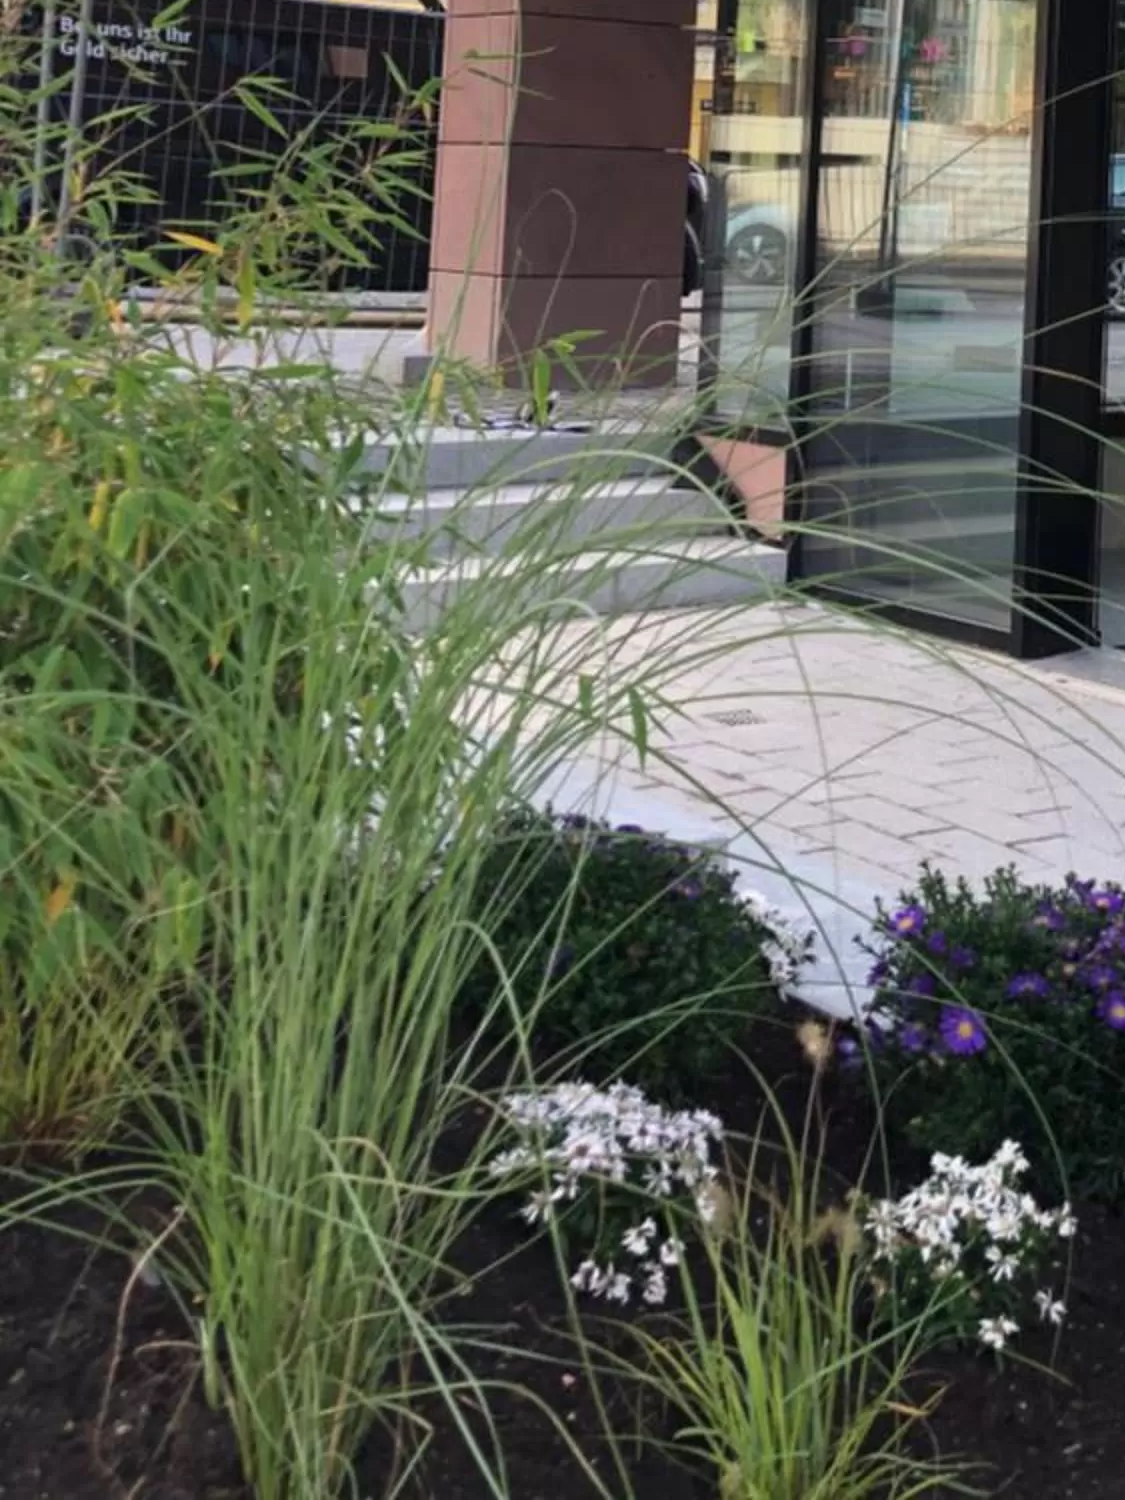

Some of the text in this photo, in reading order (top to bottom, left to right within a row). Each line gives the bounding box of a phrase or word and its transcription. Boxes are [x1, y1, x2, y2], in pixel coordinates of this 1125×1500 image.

[97, 22, 133, 38] uns
[165, 25, 193, 44] Ihr
[61, 40, 105, 58] Gld
